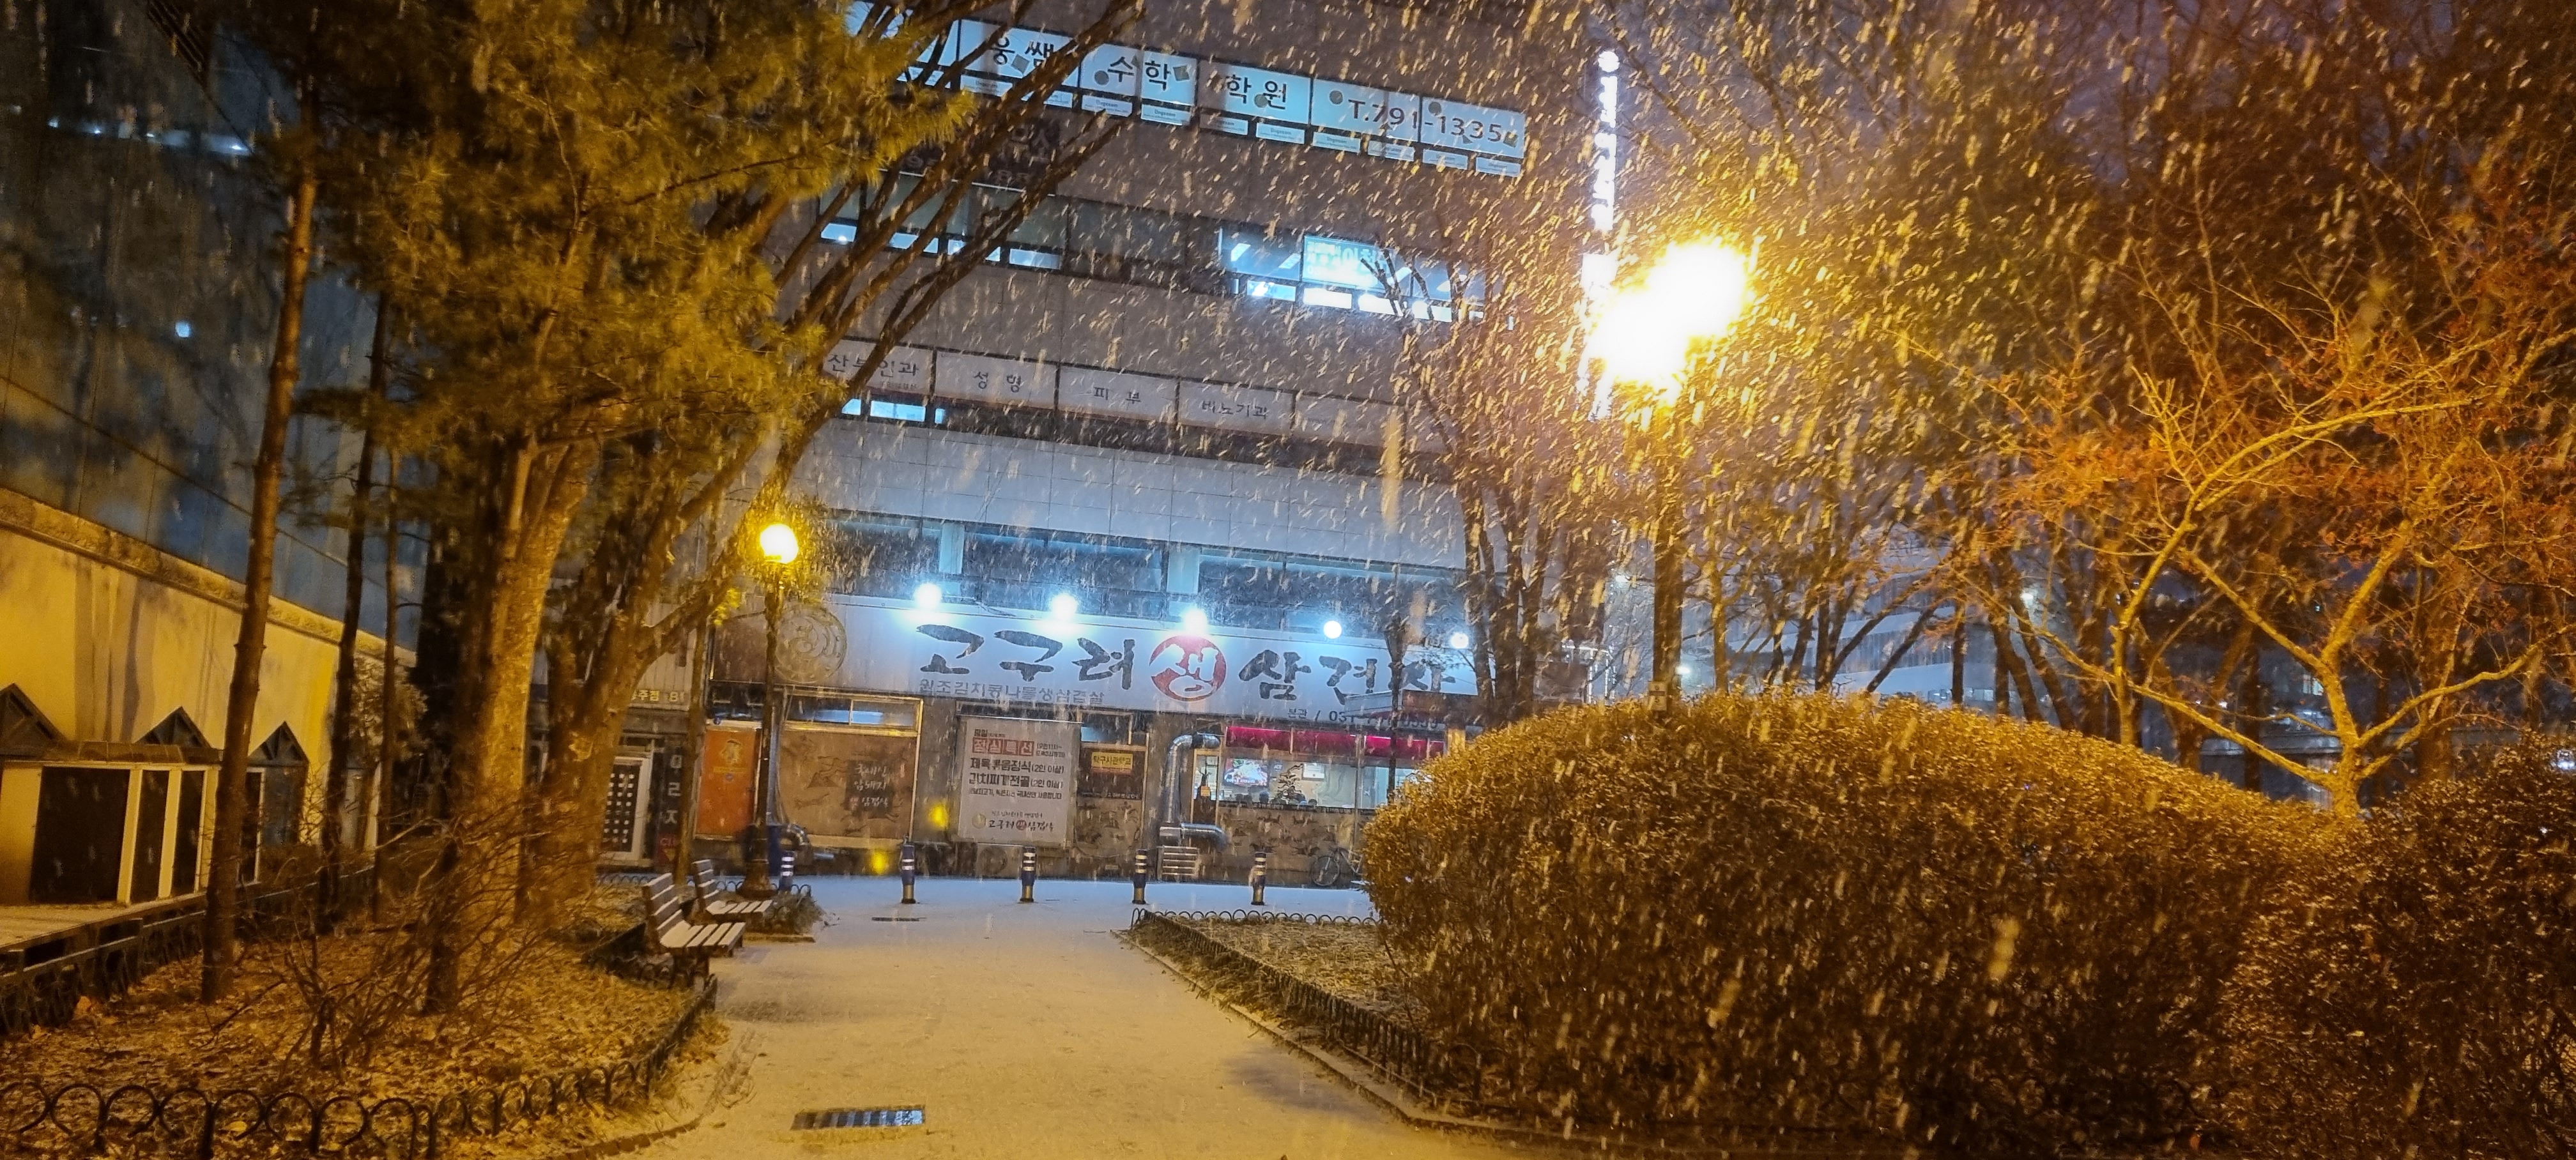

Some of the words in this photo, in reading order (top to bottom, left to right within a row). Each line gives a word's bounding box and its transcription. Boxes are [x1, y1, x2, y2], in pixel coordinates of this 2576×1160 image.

[1107, 56, 1172, 91] 수학
[1225, 73, 1287, 111] 학원
[916, 623, 1136, 691] 고구려
[1149, 637, 1225, 701] 생
[973, 738, 1034, 756] 점심특선
